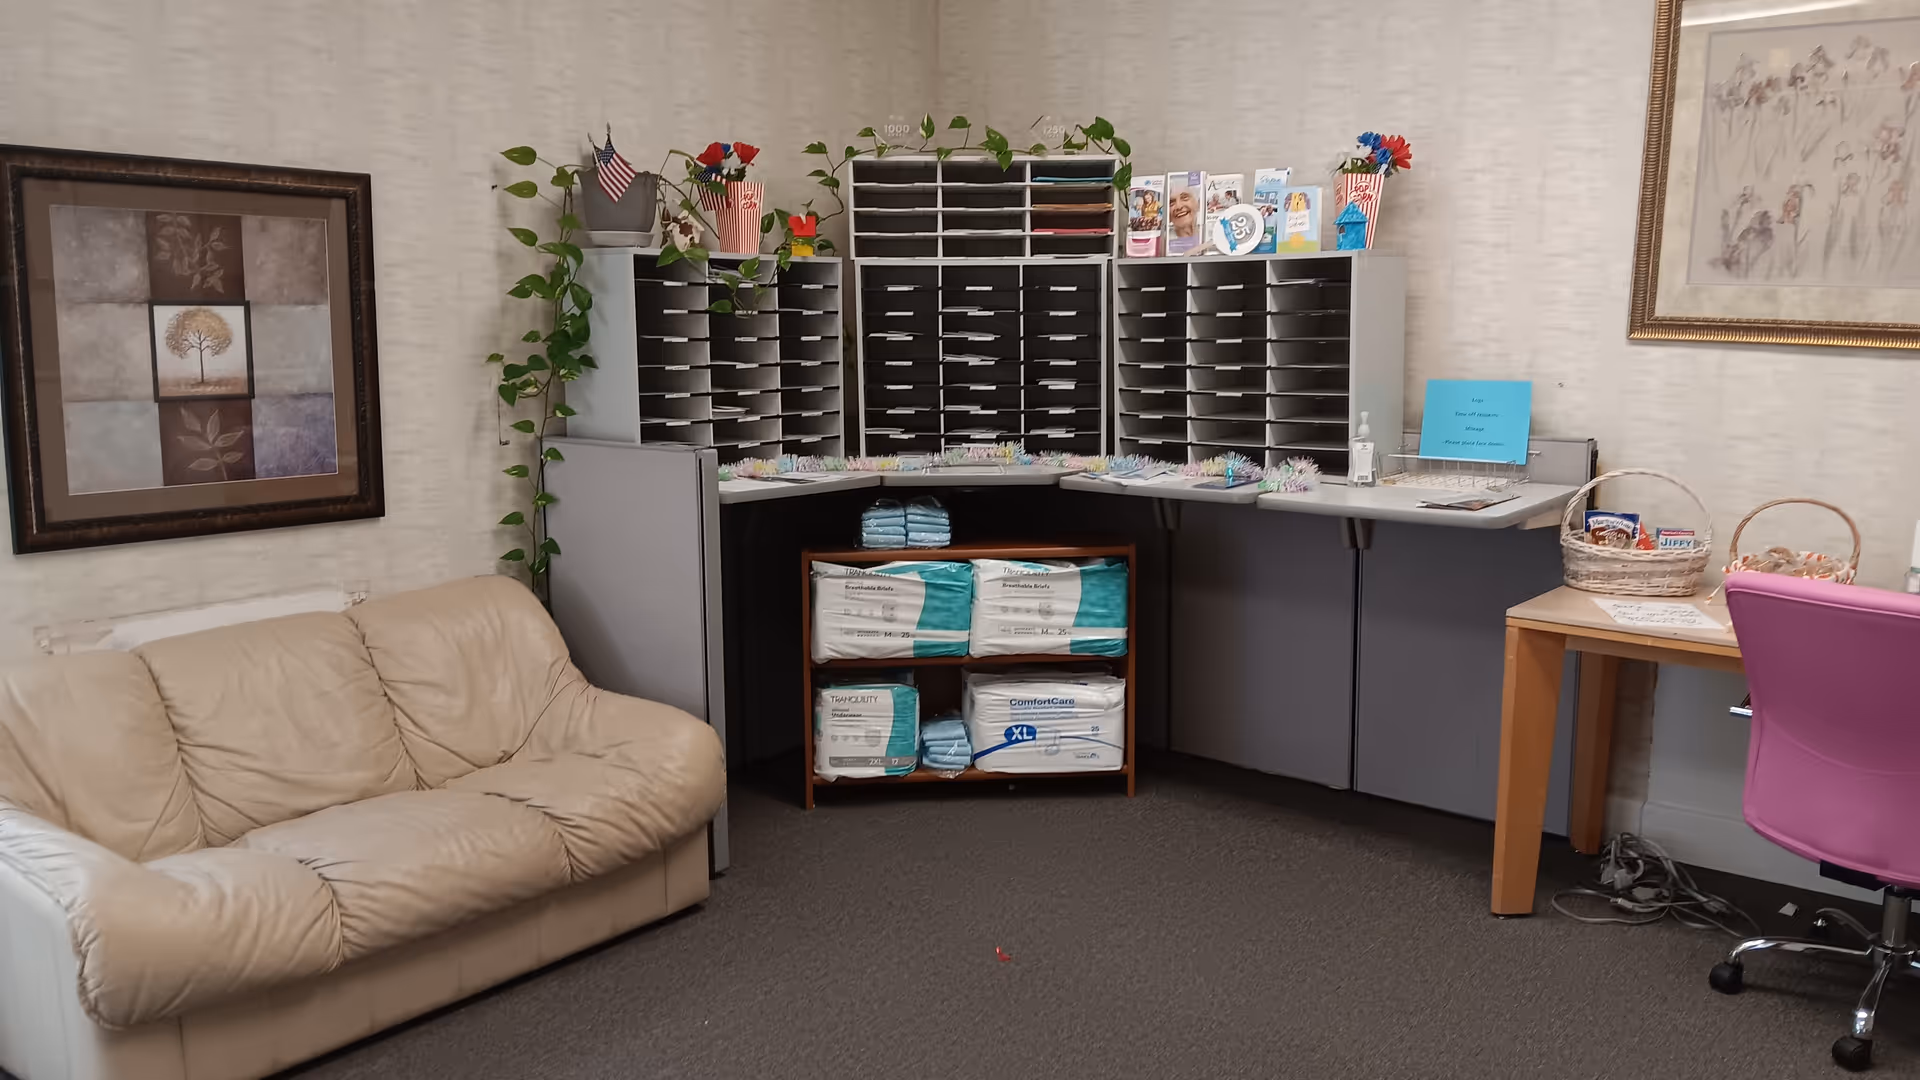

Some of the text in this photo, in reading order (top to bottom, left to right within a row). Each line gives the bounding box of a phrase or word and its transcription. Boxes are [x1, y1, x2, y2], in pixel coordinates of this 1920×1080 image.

[1354, 184, 1370, 193] POP
[1231, 216, 1251, 239] 25
[901, 631, 910, 639] 25
[1041, 628, 1049, 636] M
[1057, 628, 1067, 636] 25
[831, 695, 878, 704] TRANQUILITY
[1009, 697, 1075, 707] ComfortCare
[1011, 726, 1033, 741] XL
